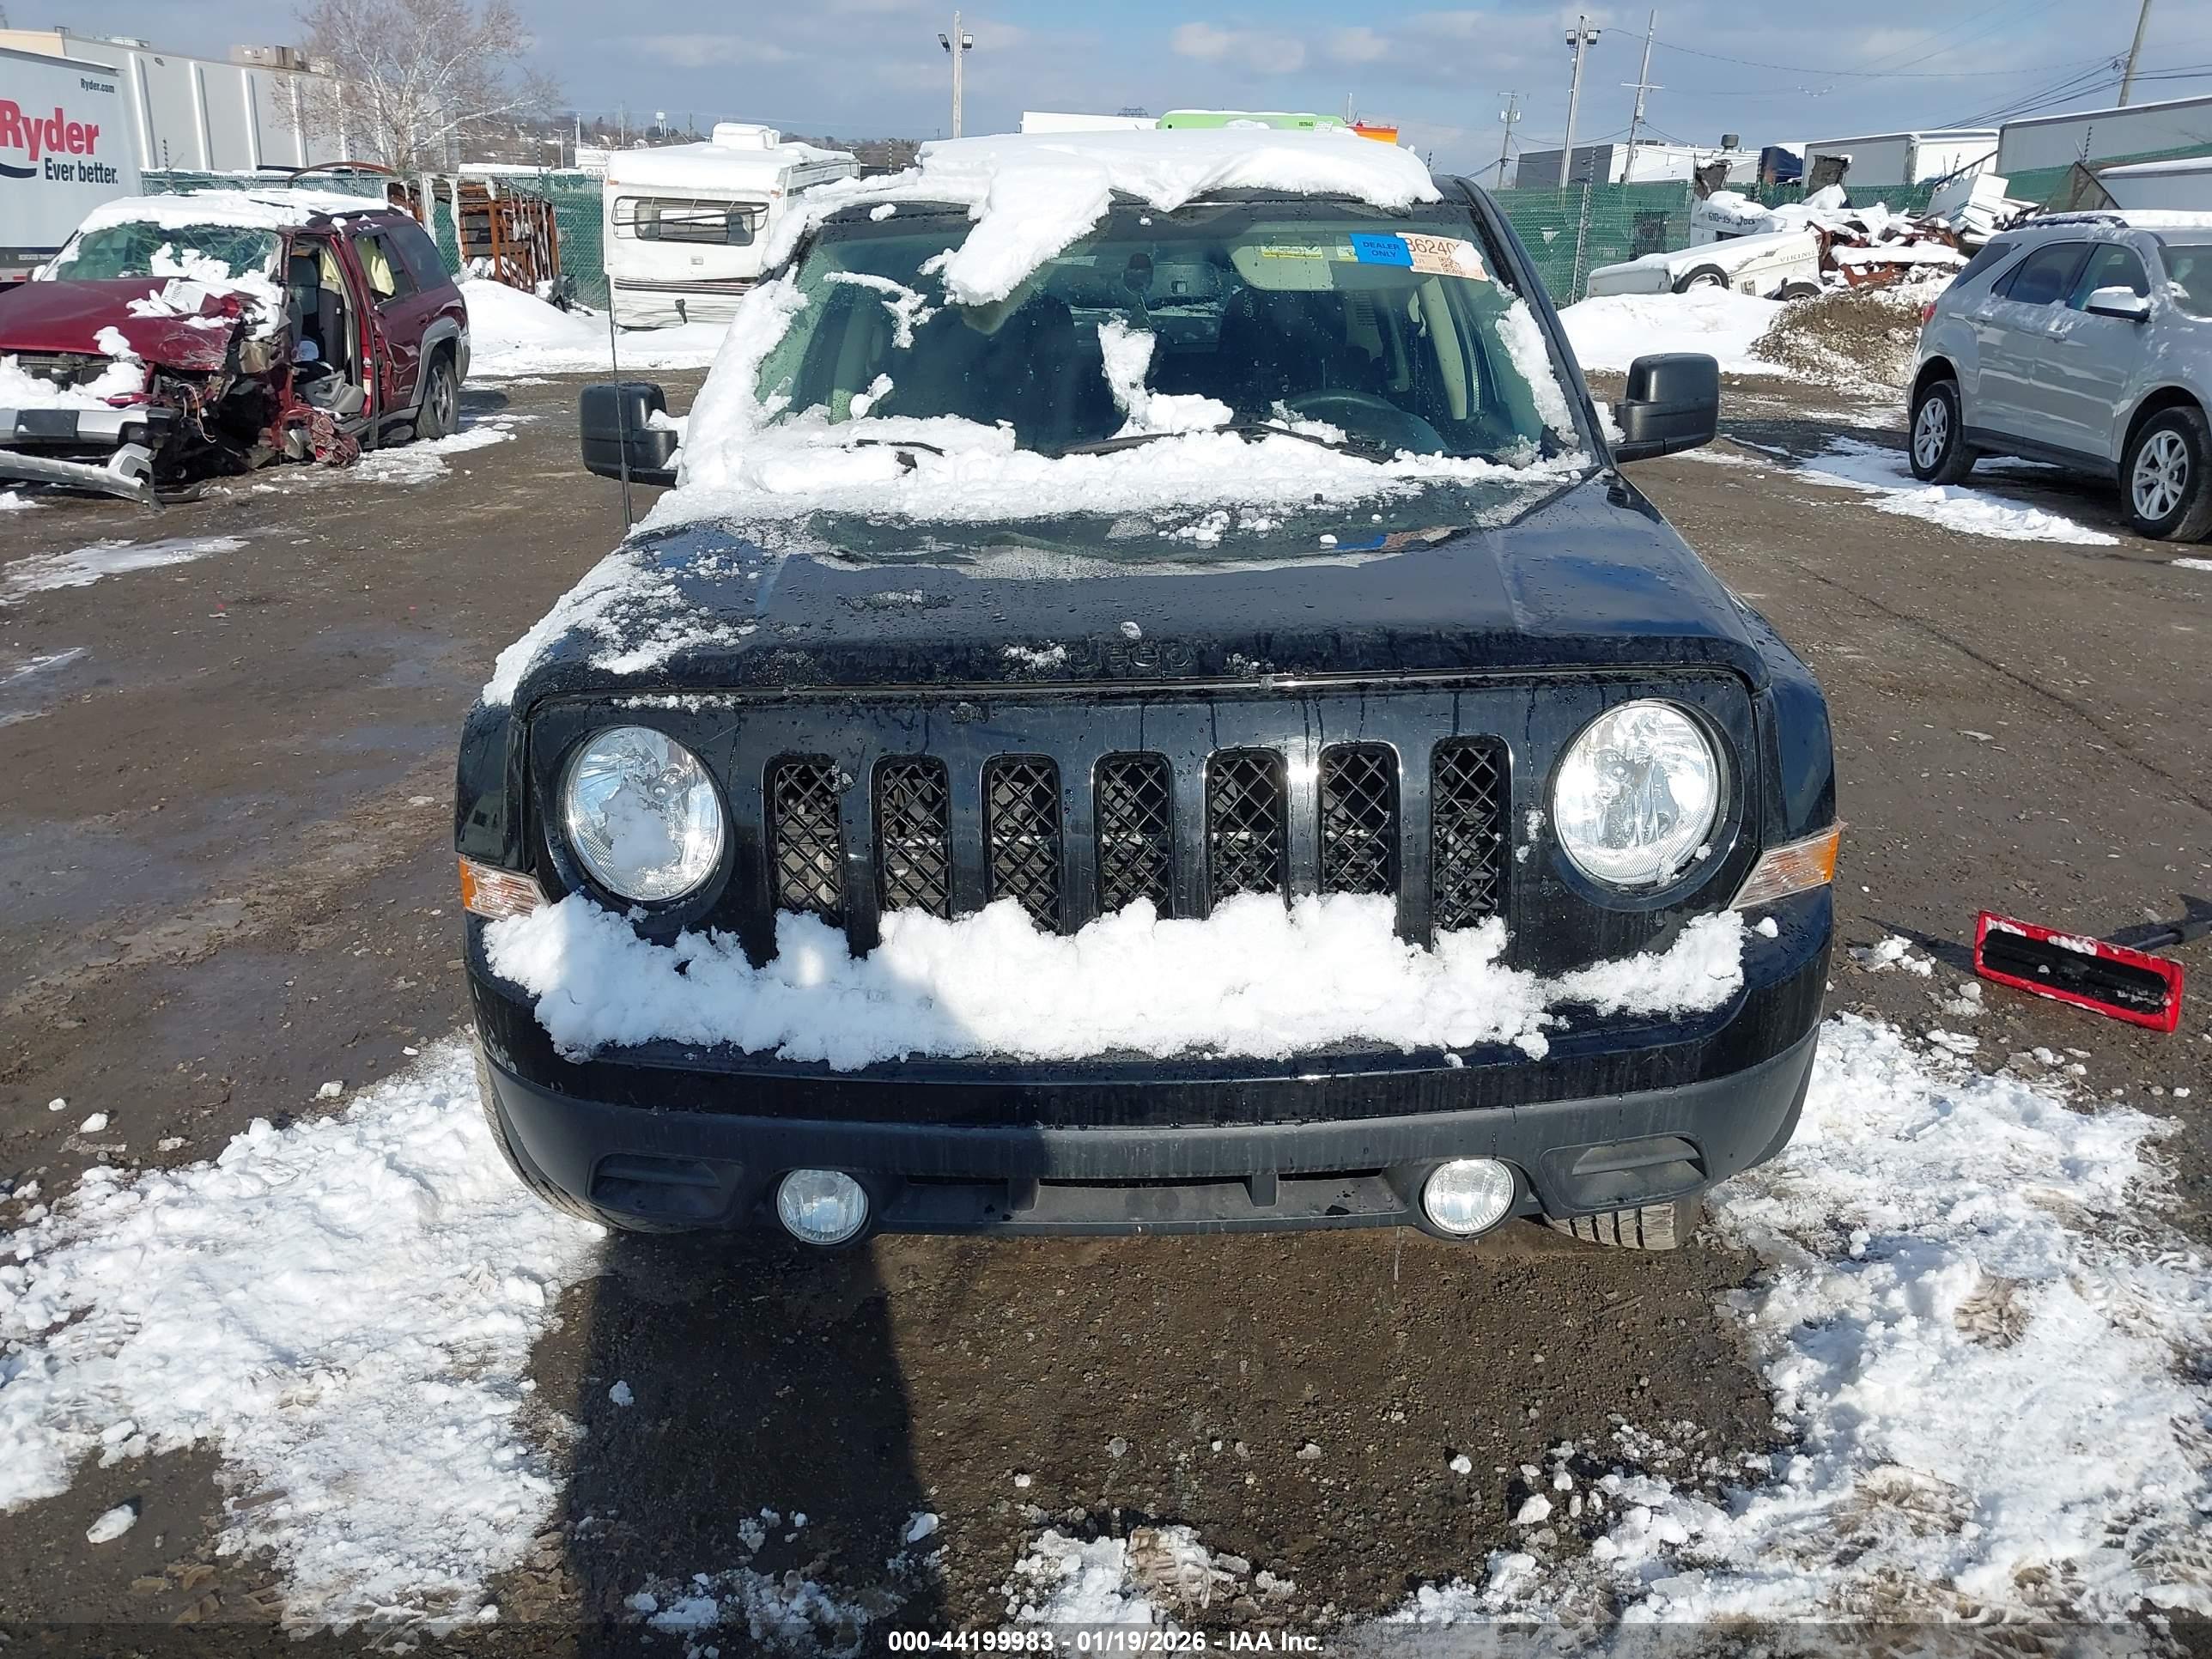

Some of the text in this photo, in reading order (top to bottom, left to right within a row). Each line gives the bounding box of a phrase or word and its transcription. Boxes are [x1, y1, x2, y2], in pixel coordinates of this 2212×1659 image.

[80, 77, 115, 94] Ryder.com
[0, 99, 100, 161] Ryder
[45, 157, 118, 184] Ever better.
[1362, 240, 1401, 251] DEALER
[1370, 249, 1396, 258] ONLY
